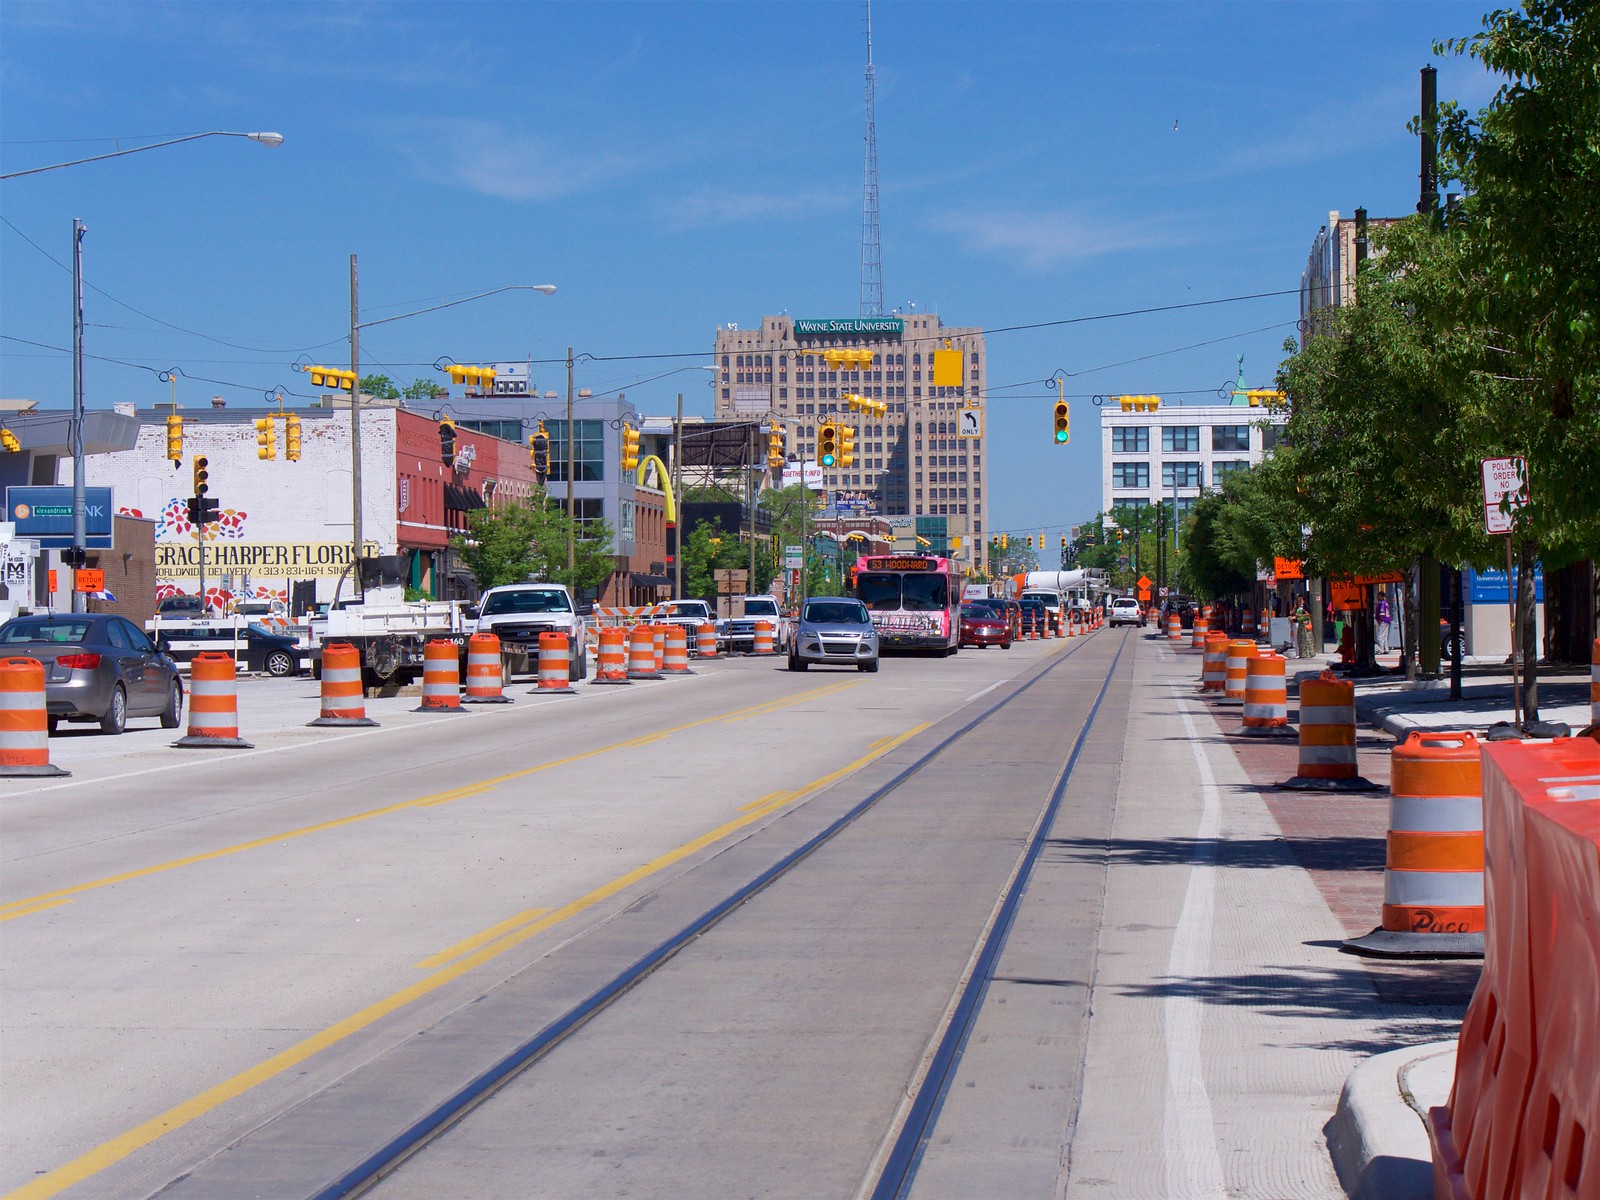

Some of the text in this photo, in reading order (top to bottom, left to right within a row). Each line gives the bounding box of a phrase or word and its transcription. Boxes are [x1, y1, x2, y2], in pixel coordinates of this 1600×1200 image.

[799, 319, 900, 332] WAYNE STATE UNIVERSITY
[1491, 462, 1516, 471] POLICE
[1493, 471, 1516, 481] ORDER
[1500, 480, 1510, 489] NO
[155, 546, 212, 566] GRACE
[215, 545, 288, 565] HARPER
[871, 560, 928, 569] 53 WOODWARD
[208, 567, 253, 576] DELIVERY
[286, 567, 324, 575] 831-1164
